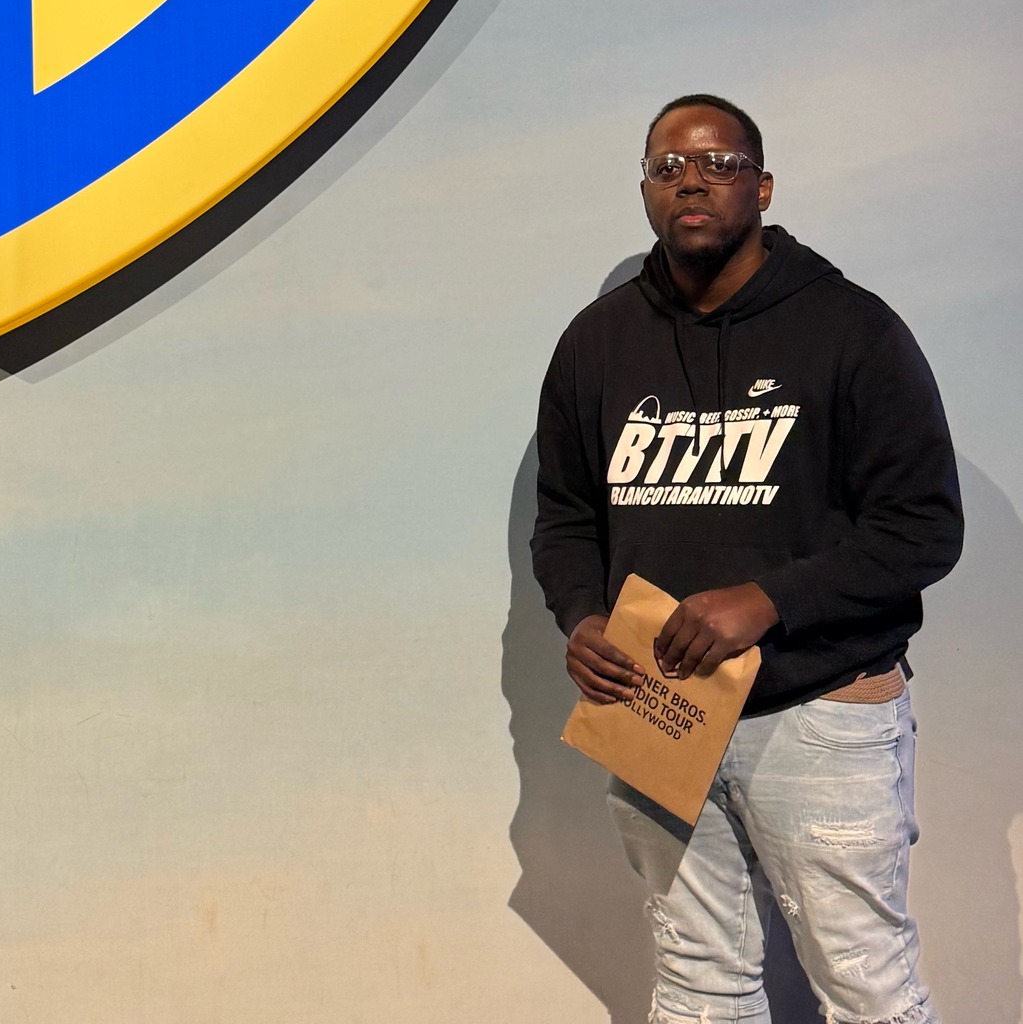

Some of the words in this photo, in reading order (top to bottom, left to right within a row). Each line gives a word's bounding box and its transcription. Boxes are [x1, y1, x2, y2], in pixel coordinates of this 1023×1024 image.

[753, 379, 776, 391] NIKE
[771, 404, 801, 418] MORE
[611, 485, 779, 506] BLANCOTARANTINOTV
[634, 686, 659, 710] DIO
[660, 703, 693, 734] TOUR
[642, 674, 670, 700] NER
[670, 692, 706, 726] BROS.
[618, 698, 682, 740] OLLYWOOD
